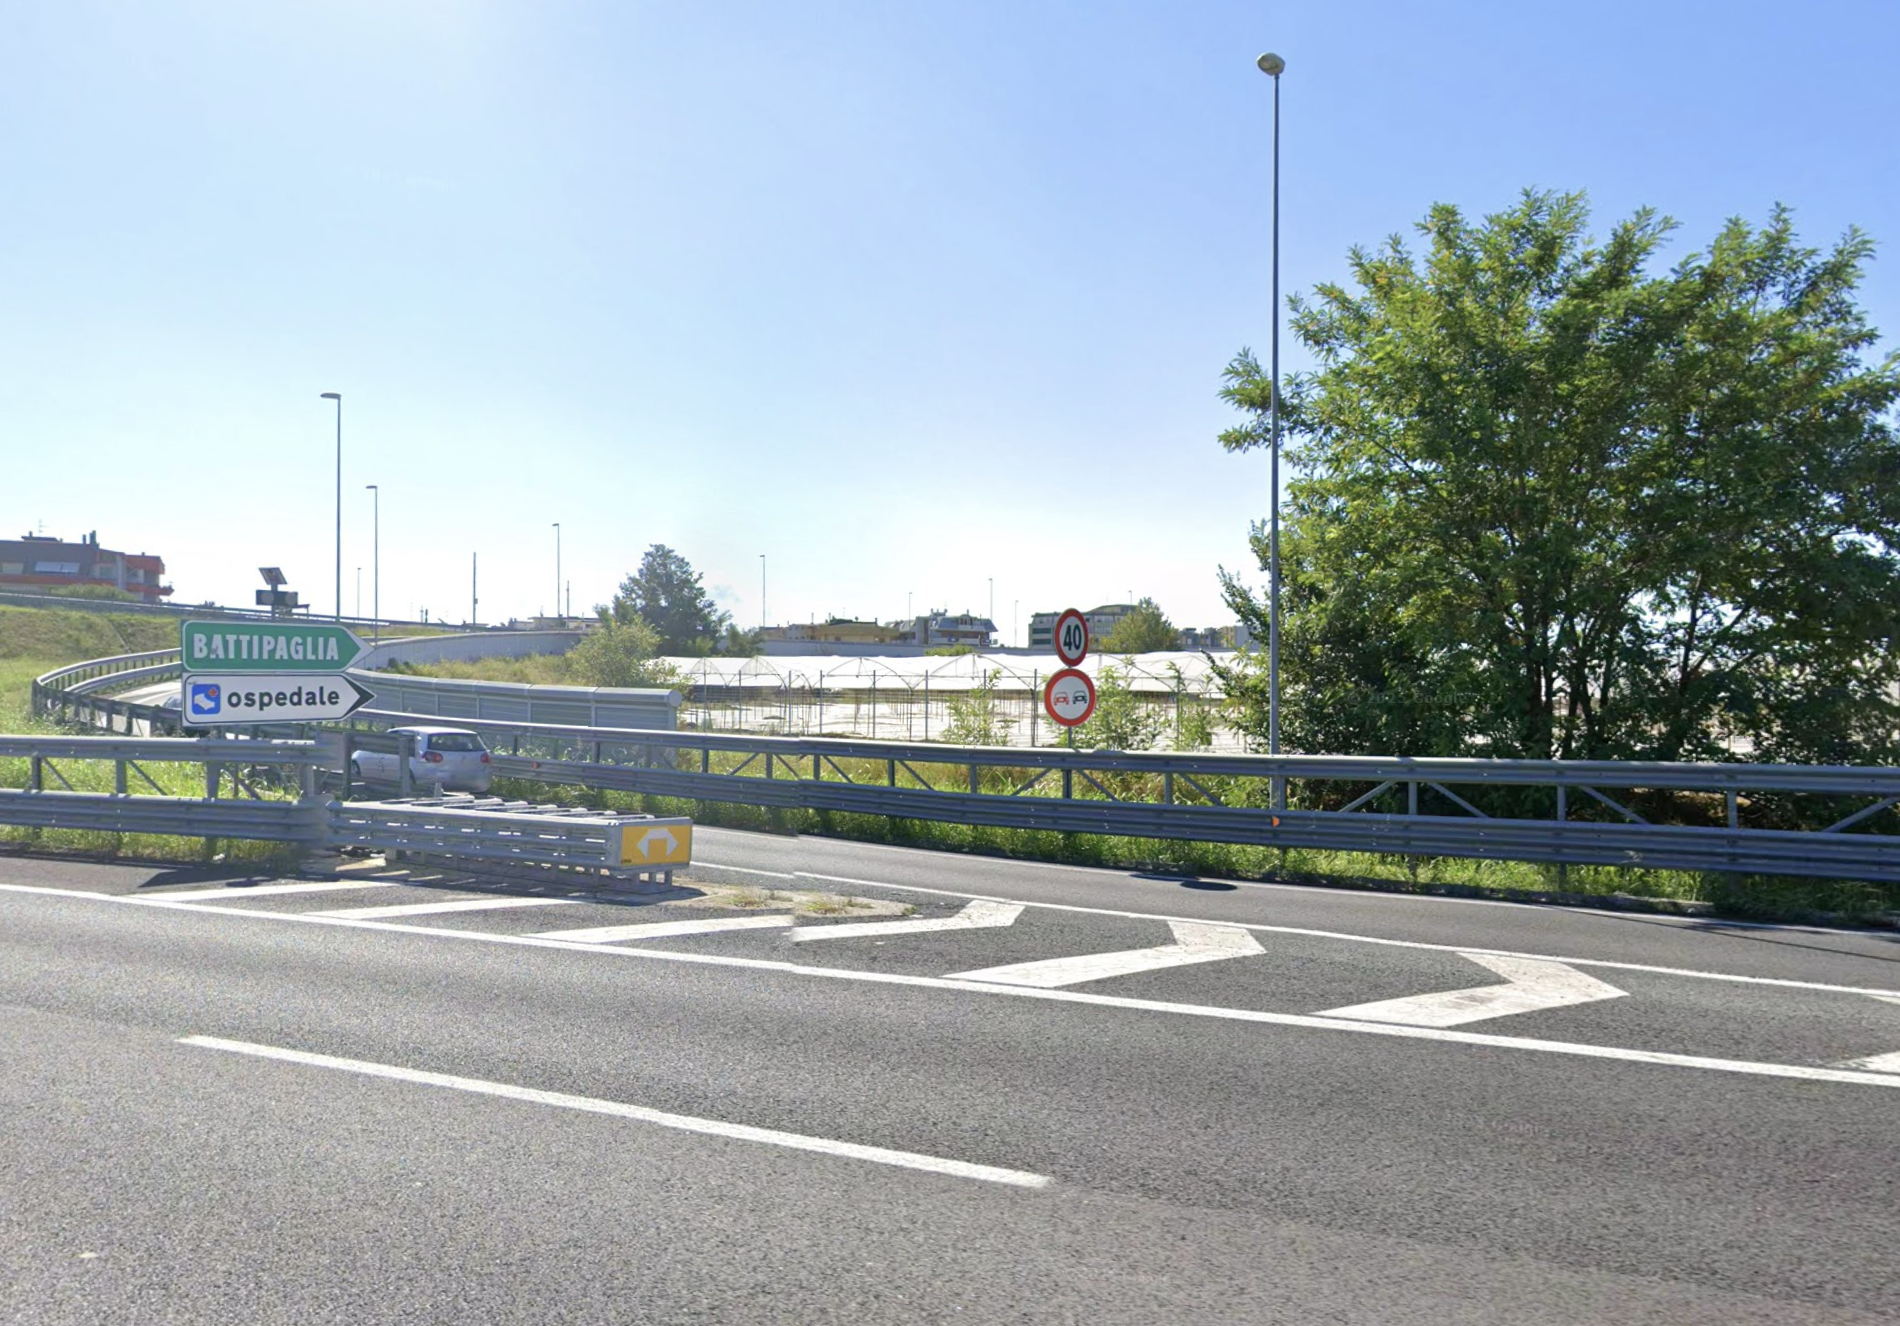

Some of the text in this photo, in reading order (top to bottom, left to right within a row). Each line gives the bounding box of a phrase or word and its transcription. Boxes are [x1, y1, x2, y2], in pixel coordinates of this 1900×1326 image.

[193, 633, 339, 661] BATTIPAGLIA
[1063, 624, 1082, 651] 40
[227, 686, 340, 711] ospedale
